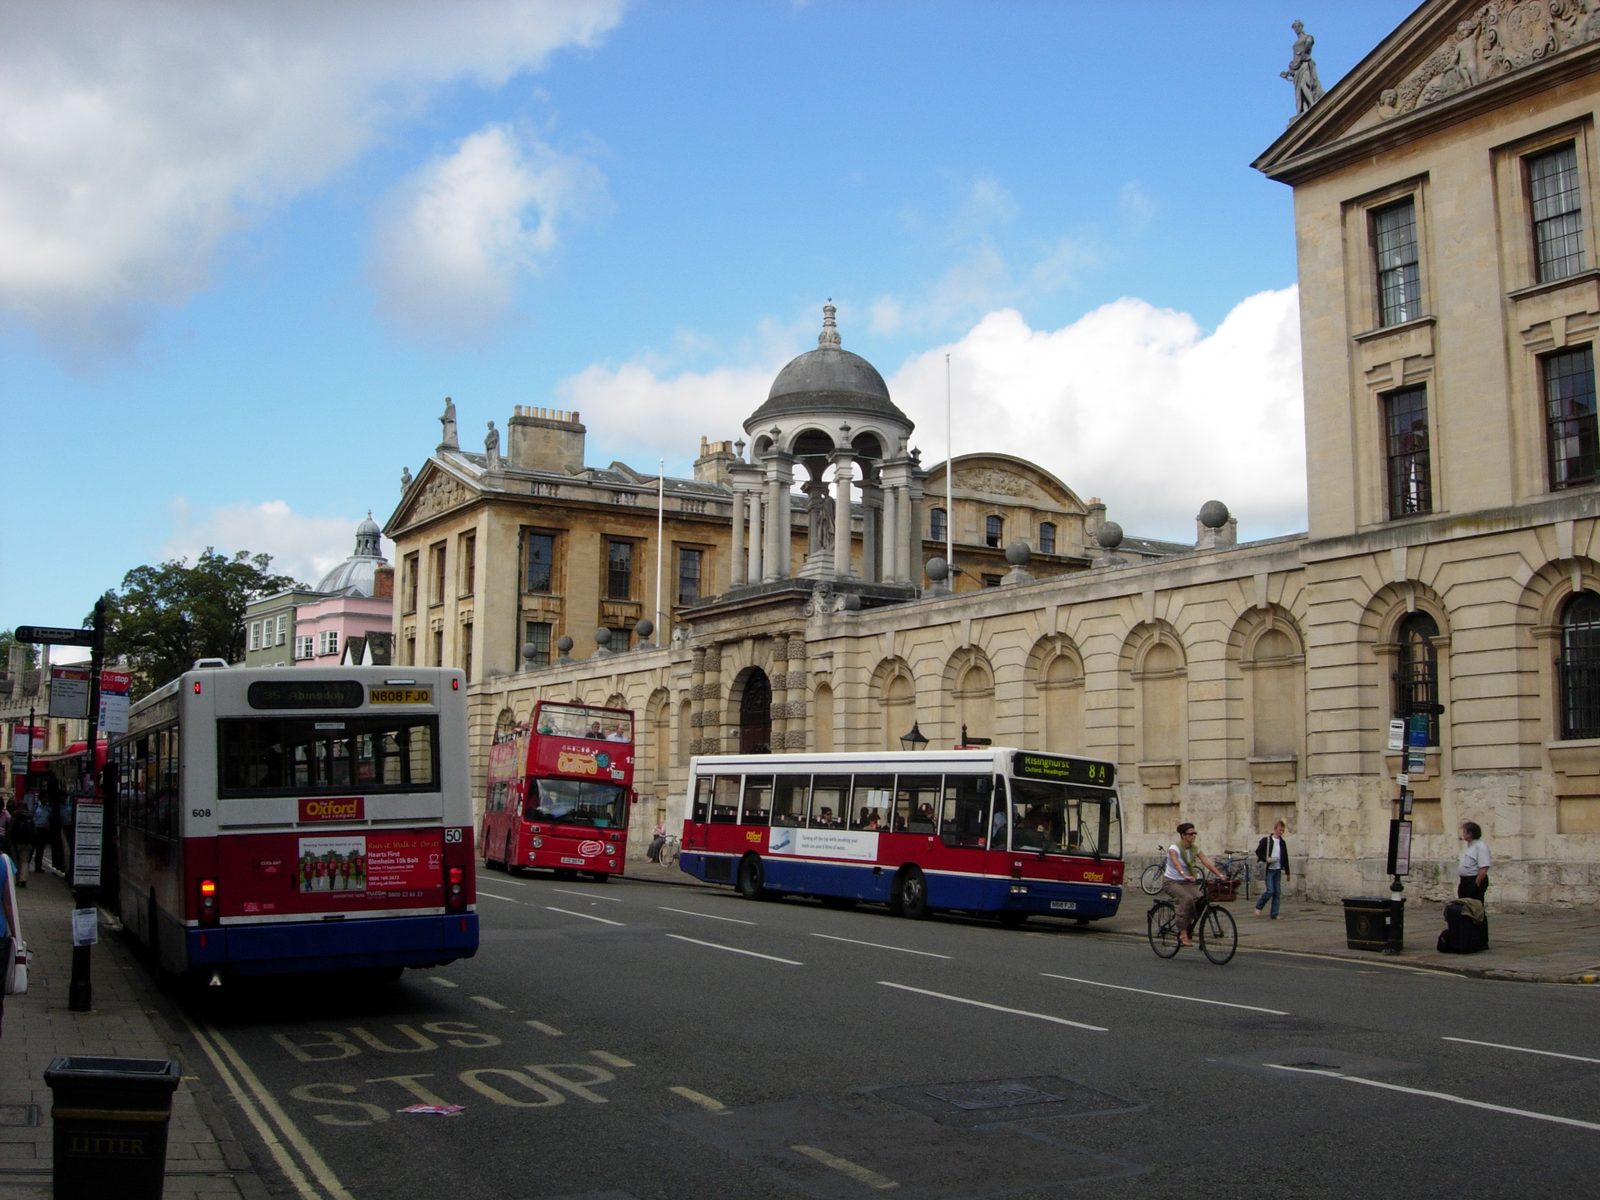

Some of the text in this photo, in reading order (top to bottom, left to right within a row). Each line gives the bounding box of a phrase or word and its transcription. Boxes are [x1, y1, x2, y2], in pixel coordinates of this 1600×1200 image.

[114, 675, 129, 685] stop
[372, 691, 428, 701] N608 FJO
[192, 808, 211, 818] 608
[306, 800, 357, 816] Oxford
[446, 830, 461, 842] 50
[271, 1021, 501, 1062] BUS
[289, 1063, 616, 1126] STOP
[71, 1136, 144, 1154] LITTER
